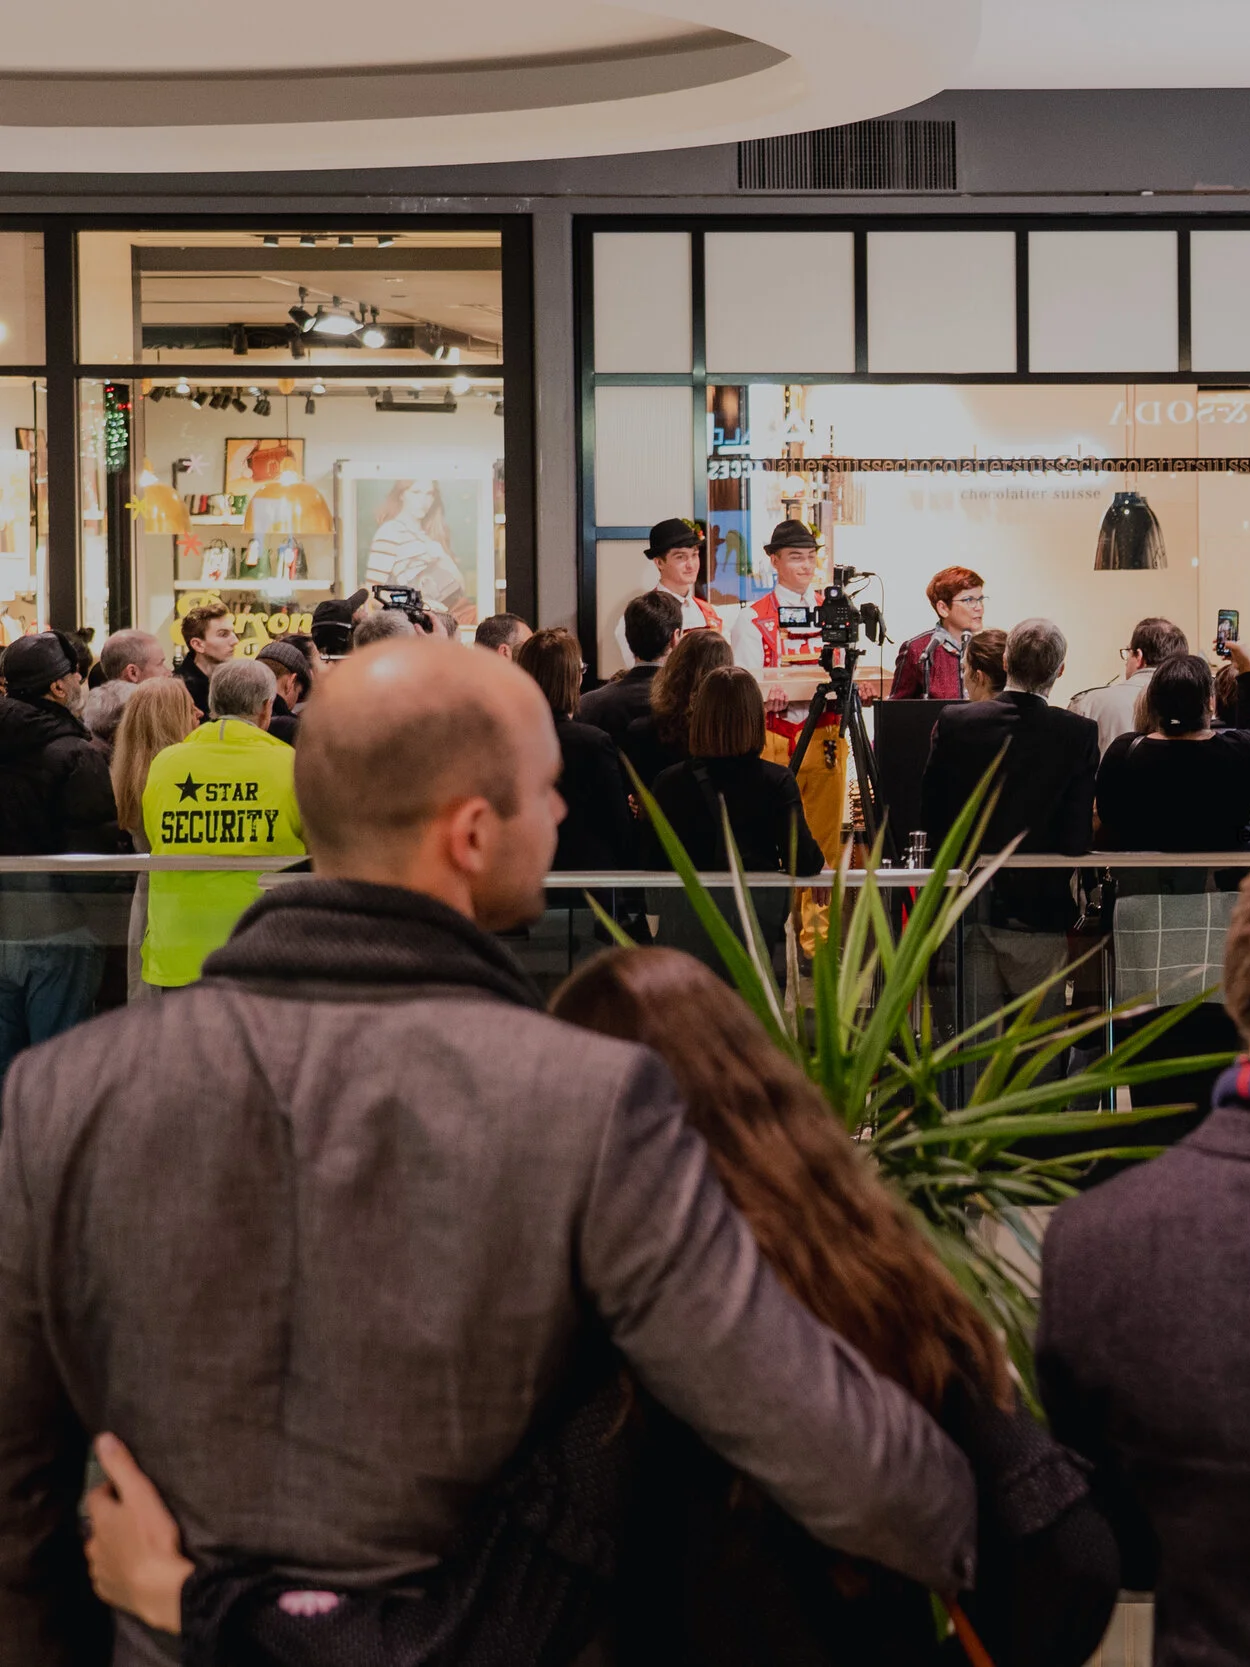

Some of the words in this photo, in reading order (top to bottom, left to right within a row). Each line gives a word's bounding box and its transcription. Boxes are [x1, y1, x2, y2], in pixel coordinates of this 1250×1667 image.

[960, 488, 1047, 500] chocolatier
[1053, 488, 1101, 500] suisse
[205, 782, 259, 802] STAR
[161, 810, 279, 844] SECURITY
